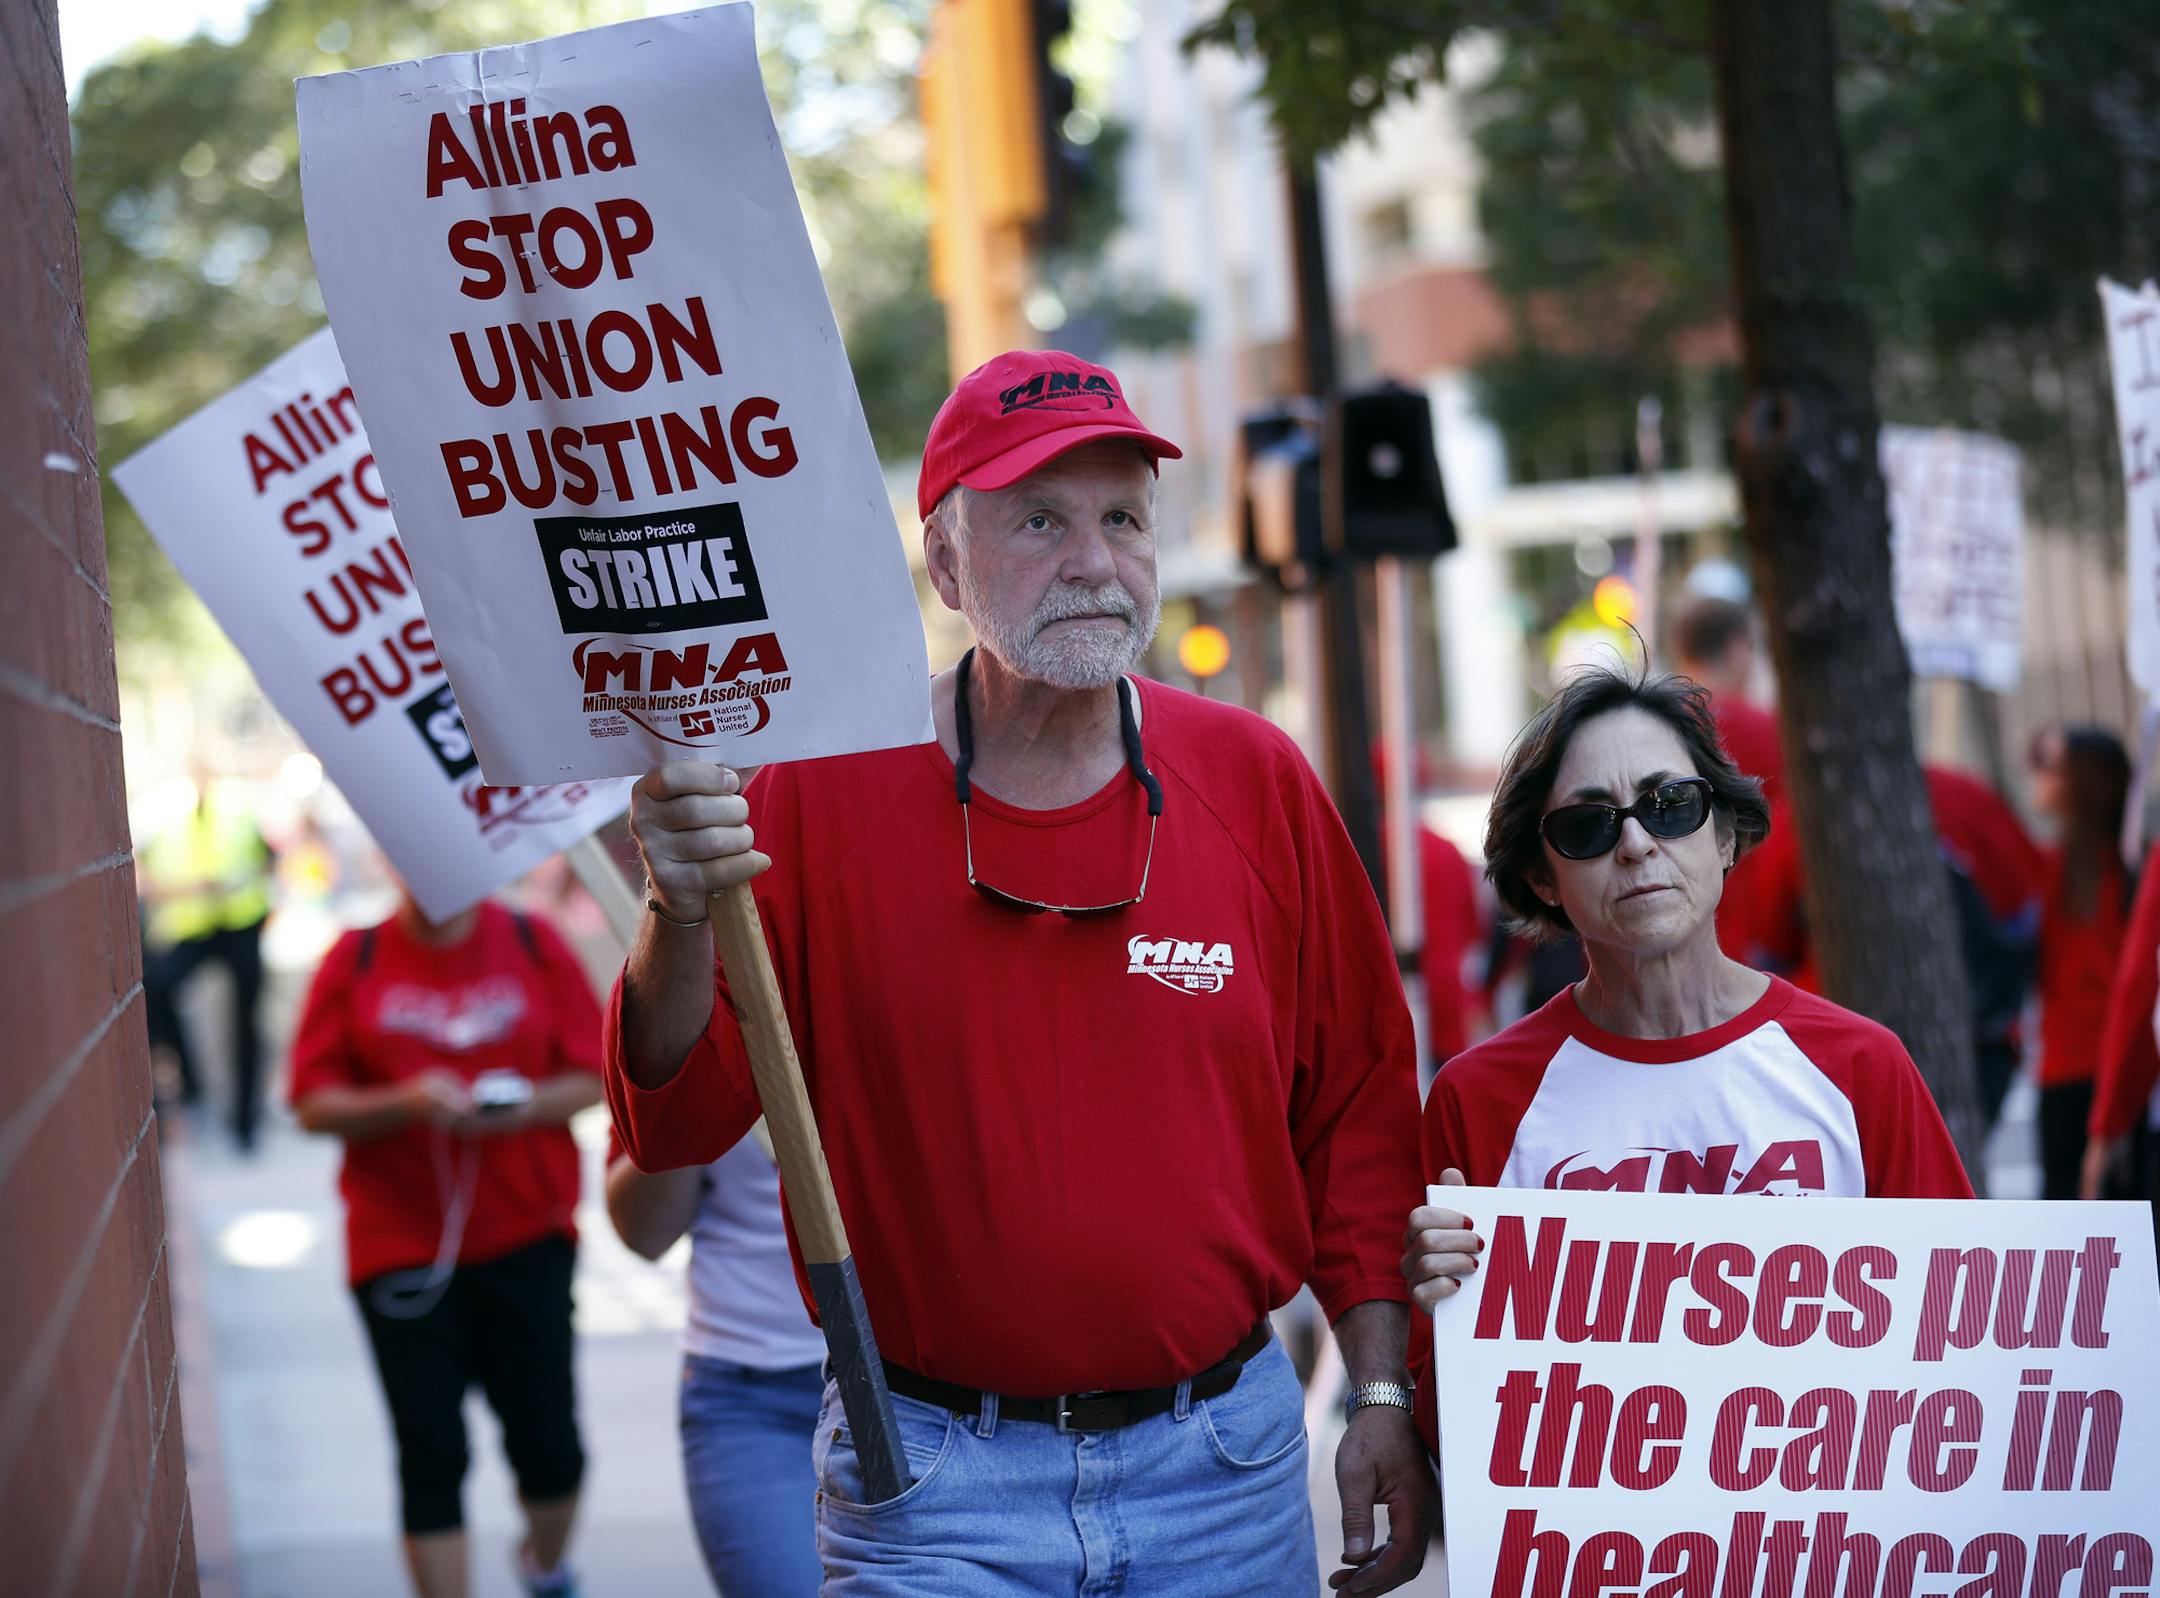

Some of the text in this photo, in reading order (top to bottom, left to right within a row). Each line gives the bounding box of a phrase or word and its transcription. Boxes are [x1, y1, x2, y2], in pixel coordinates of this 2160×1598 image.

[426, 97, 637, 199] Allina
[448, 198, 655, 300] STOP
[450, 296, 724, 408] UNION
[1004, 372, 1115, 406] MNA
[440, 396, 800, 519] BUSTING
[578, 520, 697, 544] Unfair Labor Practice
[559, 536, 747, 611] STRIKE
[583, 676, 792, 713] Minnesota Nurses Association
[713, 702, 752, 716] National
[715, 713, 747, 725] Nurses
[718, 720, 749, 733] United
[1129, 940, 1235, 967] MNA
[1473, 1215, 2122, 1362] Nurses put
[1488, 1362, 2124, 1494] the care in
[1491, 1509, 2154, 1598] healthcare
